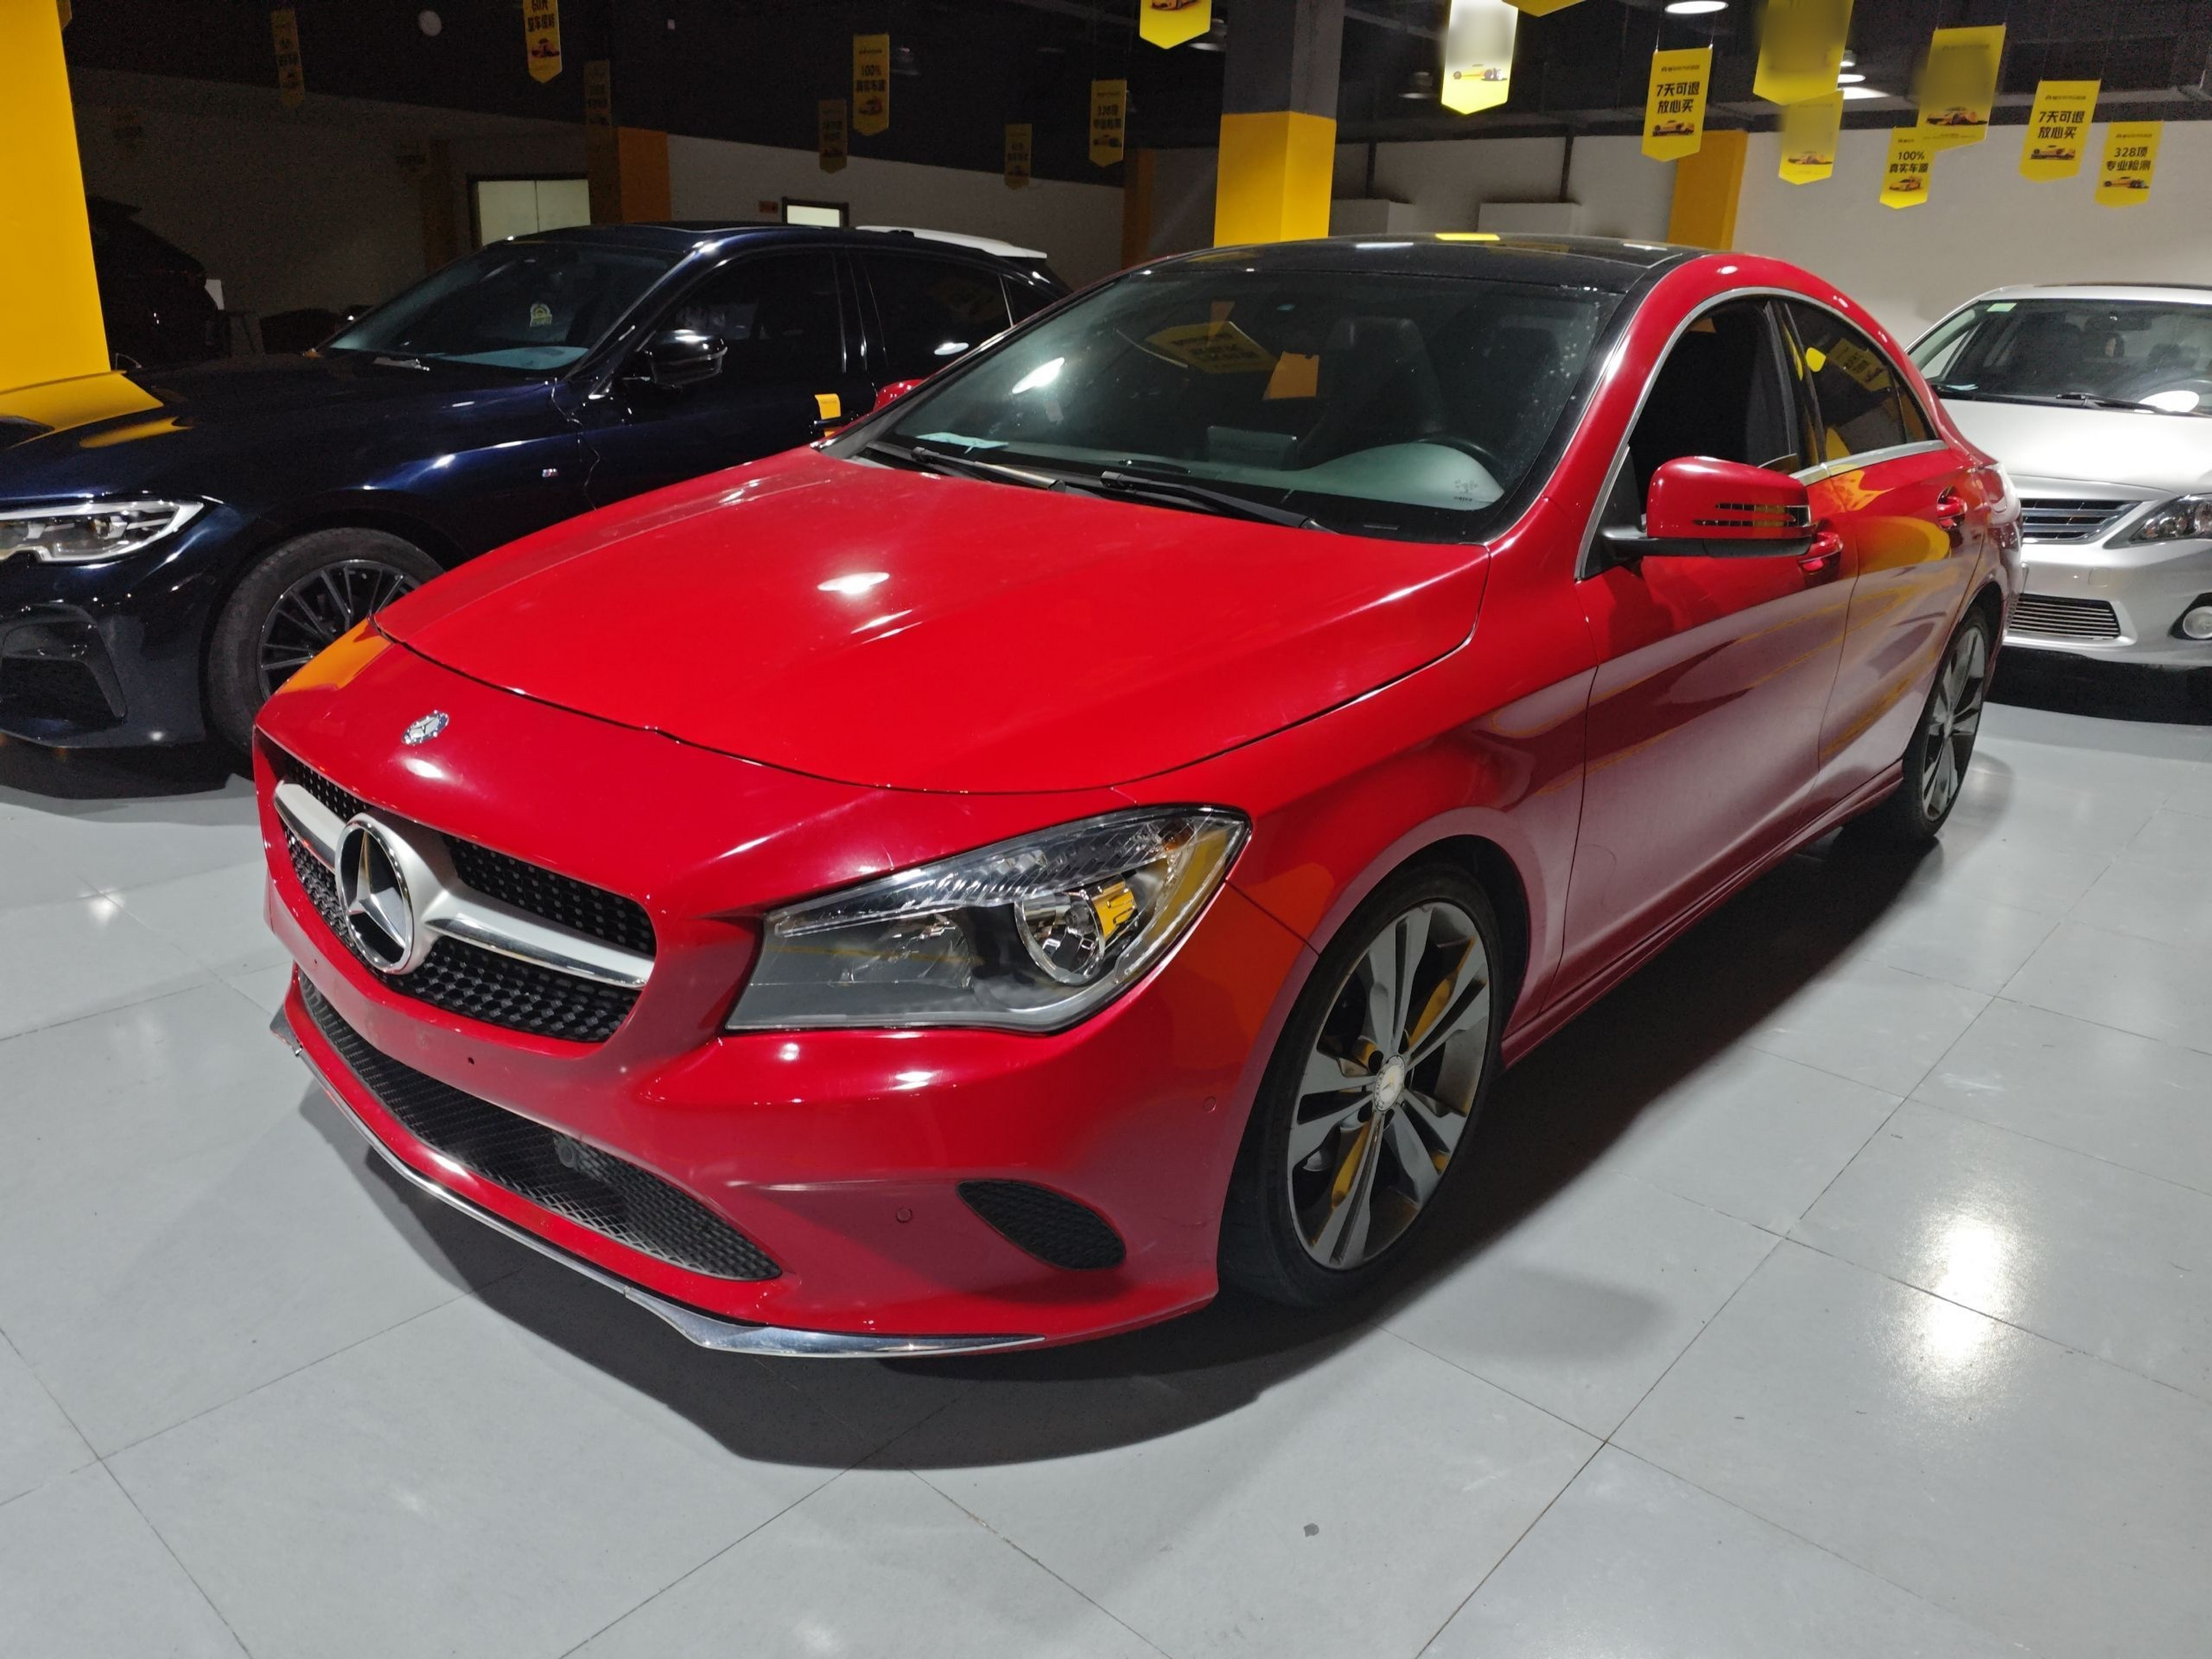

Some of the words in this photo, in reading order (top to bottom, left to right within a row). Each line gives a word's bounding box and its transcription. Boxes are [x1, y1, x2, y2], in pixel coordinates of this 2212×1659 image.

[1656, 81, 1700, 97] 7天可退
[1657, 99, 1694, 114] 放心买
[2038, 110, 2085, 123] 7天可退
[2037, 126, 2077, 139] 放心买
[1898, 150, 1925, 161] 100%
[2114, 146, 2149, 158] 328项
[2106, 160, 2152, 171] 专业检测
